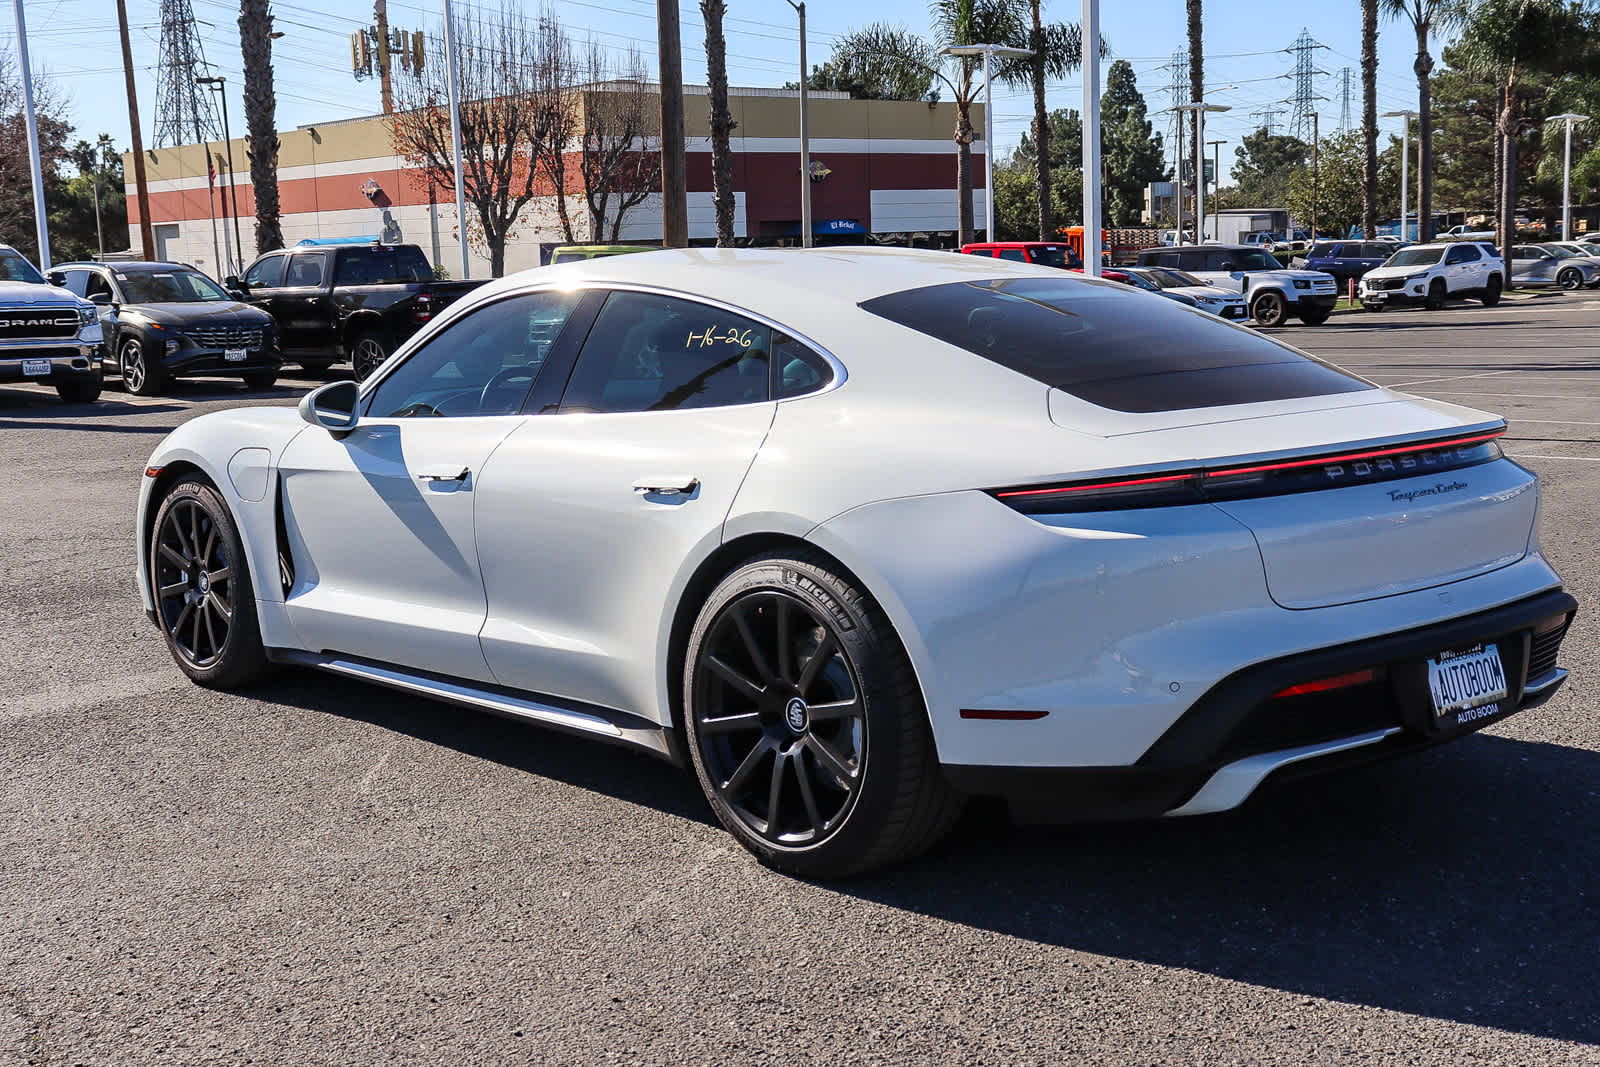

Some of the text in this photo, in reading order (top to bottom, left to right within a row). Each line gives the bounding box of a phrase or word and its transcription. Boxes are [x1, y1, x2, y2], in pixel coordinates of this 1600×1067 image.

[1324, 448, 1472, 479] PORSCHE
[798, 577, 852, 629] MICHELIN
[1438, 655, 1505, 706] AUTOBOOM
[1457, 703, 1499, 724] AUTO BOOM
